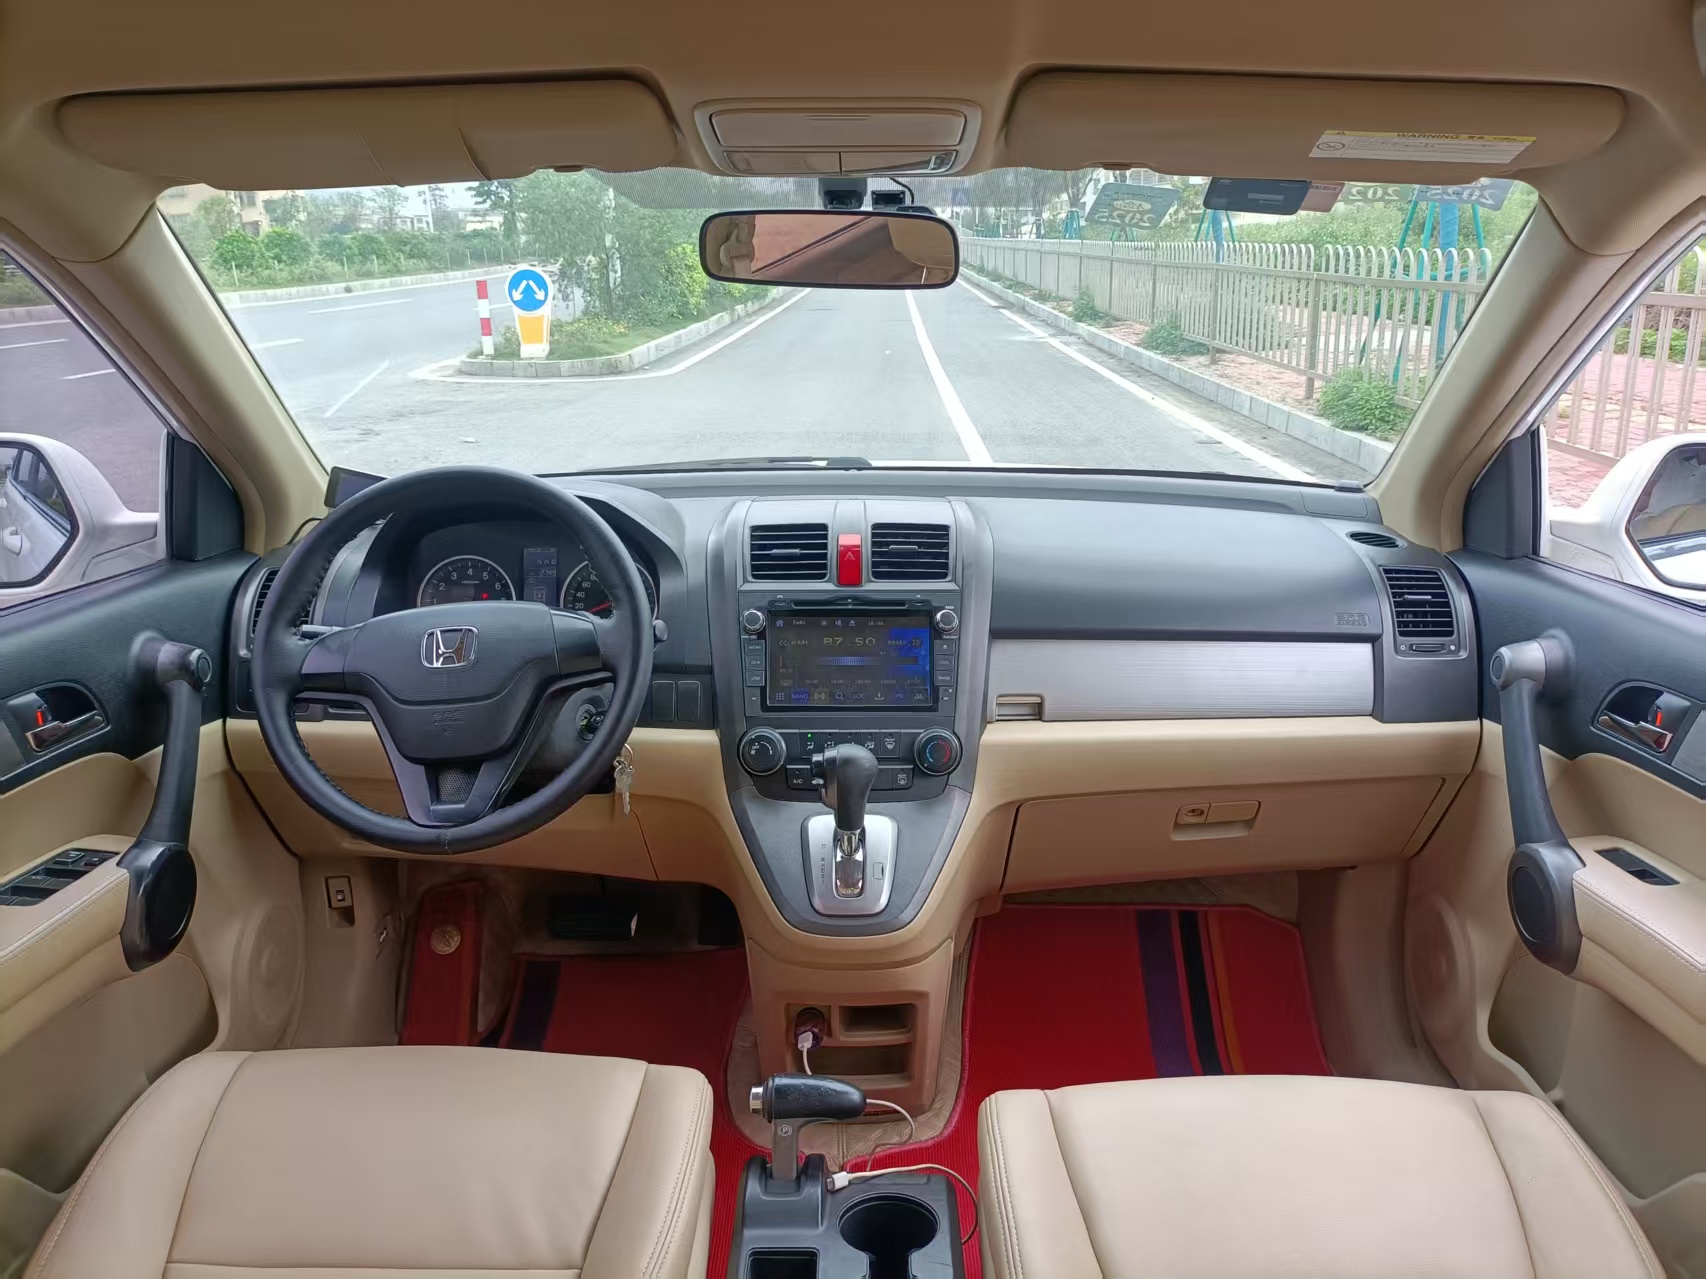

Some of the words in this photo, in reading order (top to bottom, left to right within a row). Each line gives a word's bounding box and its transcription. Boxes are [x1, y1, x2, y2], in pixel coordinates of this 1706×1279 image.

[1397, 132, 1461, 140] WARNING
[451, 572, 457, 580] 3
[466, 568, 473, 576] 4
[482, 572, 489, 580] 5
[439, 583, 445, 591] 2
